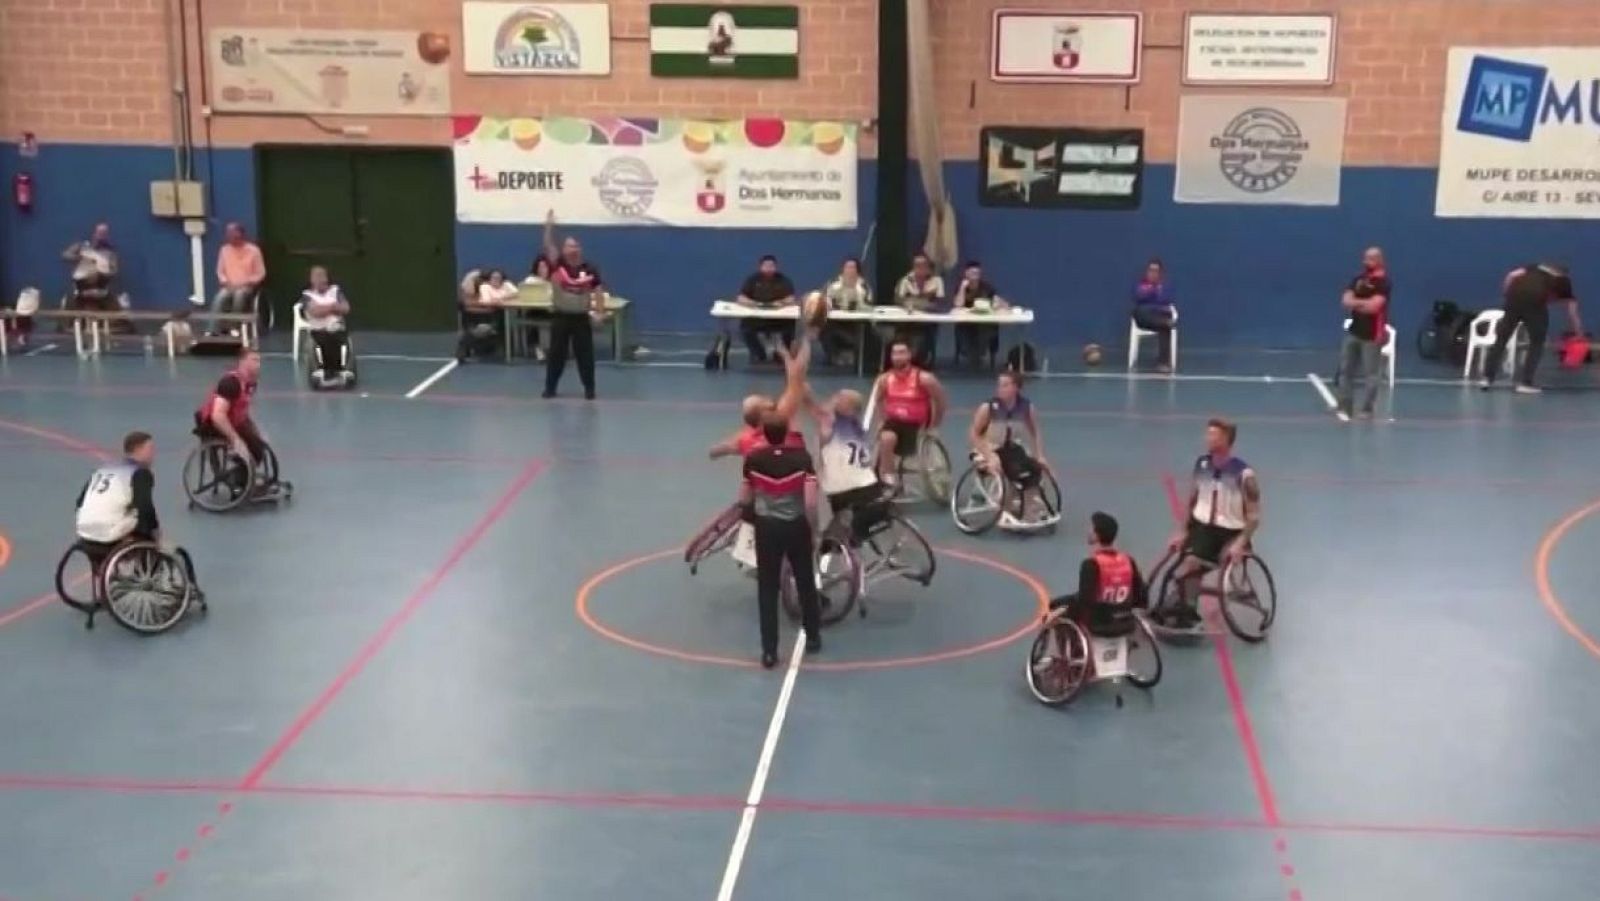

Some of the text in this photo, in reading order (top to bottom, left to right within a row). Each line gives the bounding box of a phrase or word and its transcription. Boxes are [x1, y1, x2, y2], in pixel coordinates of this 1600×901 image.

[1476, 82, 1528, 116] MP
[499, 171, 565, 190] DEPORTE
[1466, 168, 1512, 181] MUPE
[738, 185, 767, 199] Dos
